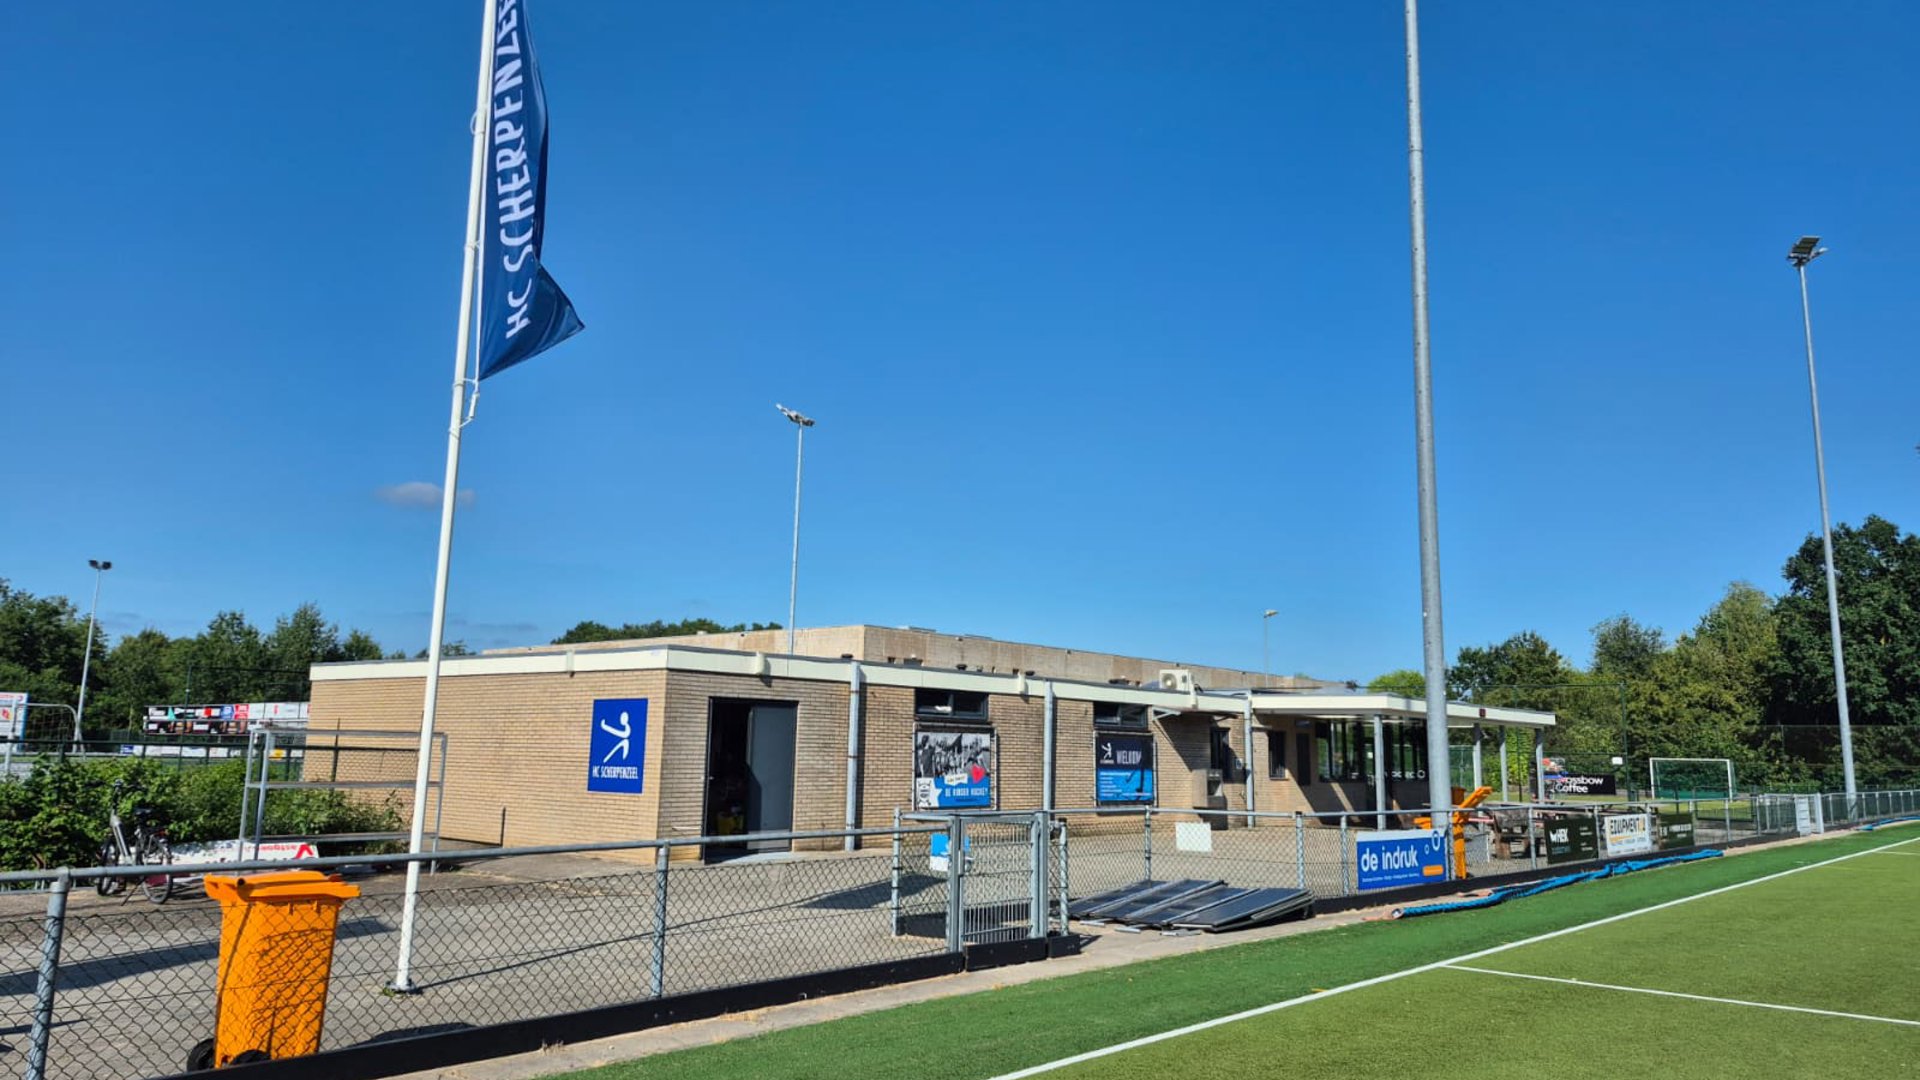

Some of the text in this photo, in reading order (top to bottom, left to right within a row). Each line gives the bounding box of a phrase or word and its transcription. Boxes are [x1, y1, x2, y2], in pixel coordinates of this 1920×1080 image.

[505, 278, 532, 340] HC
[1555, 783, 1589, 793] Coffee
[1361, 844, 1419, 872] de indruk
